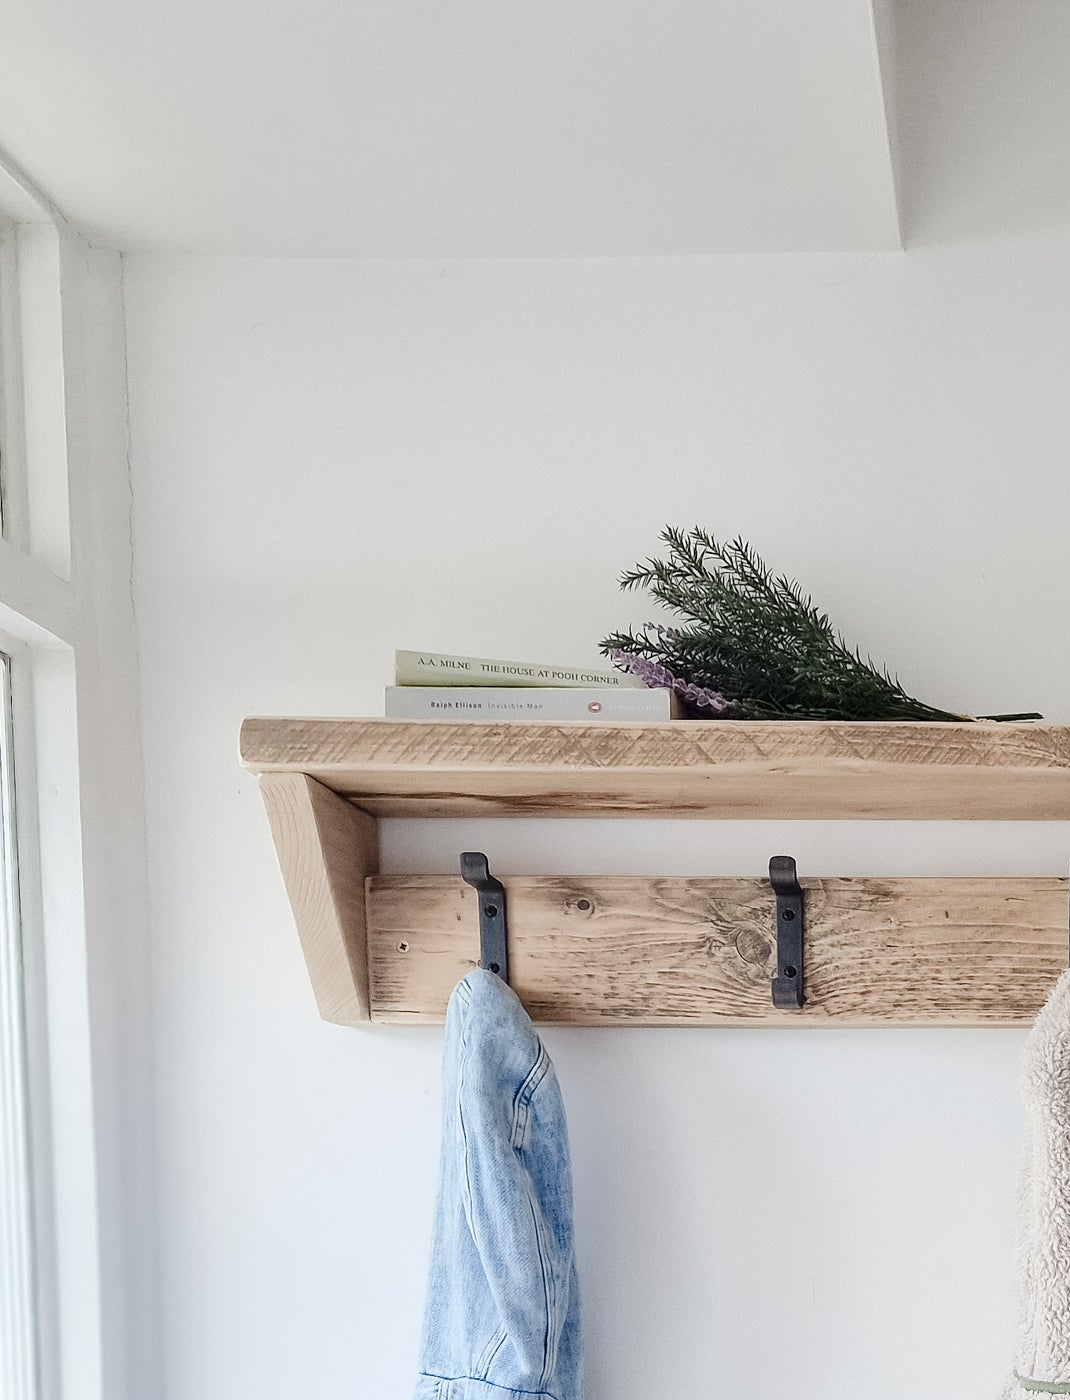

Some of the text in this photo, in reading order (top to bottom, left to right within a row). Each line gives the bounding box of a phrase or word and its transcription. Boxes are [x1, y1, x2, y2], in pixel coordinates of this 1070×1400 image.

[440, 660, 471, 670] MILNE
[481, 664, 500, 673] THE
[502, 666, 534, 676] HOUSE
[537, 670, 549, 678] AT
[552, 672, 579, 681] POOH
[580, 674, 619, 685] CORNER
[430, 701, 453, 709] Ralph
[455, 701, 482, 709] Ellison
